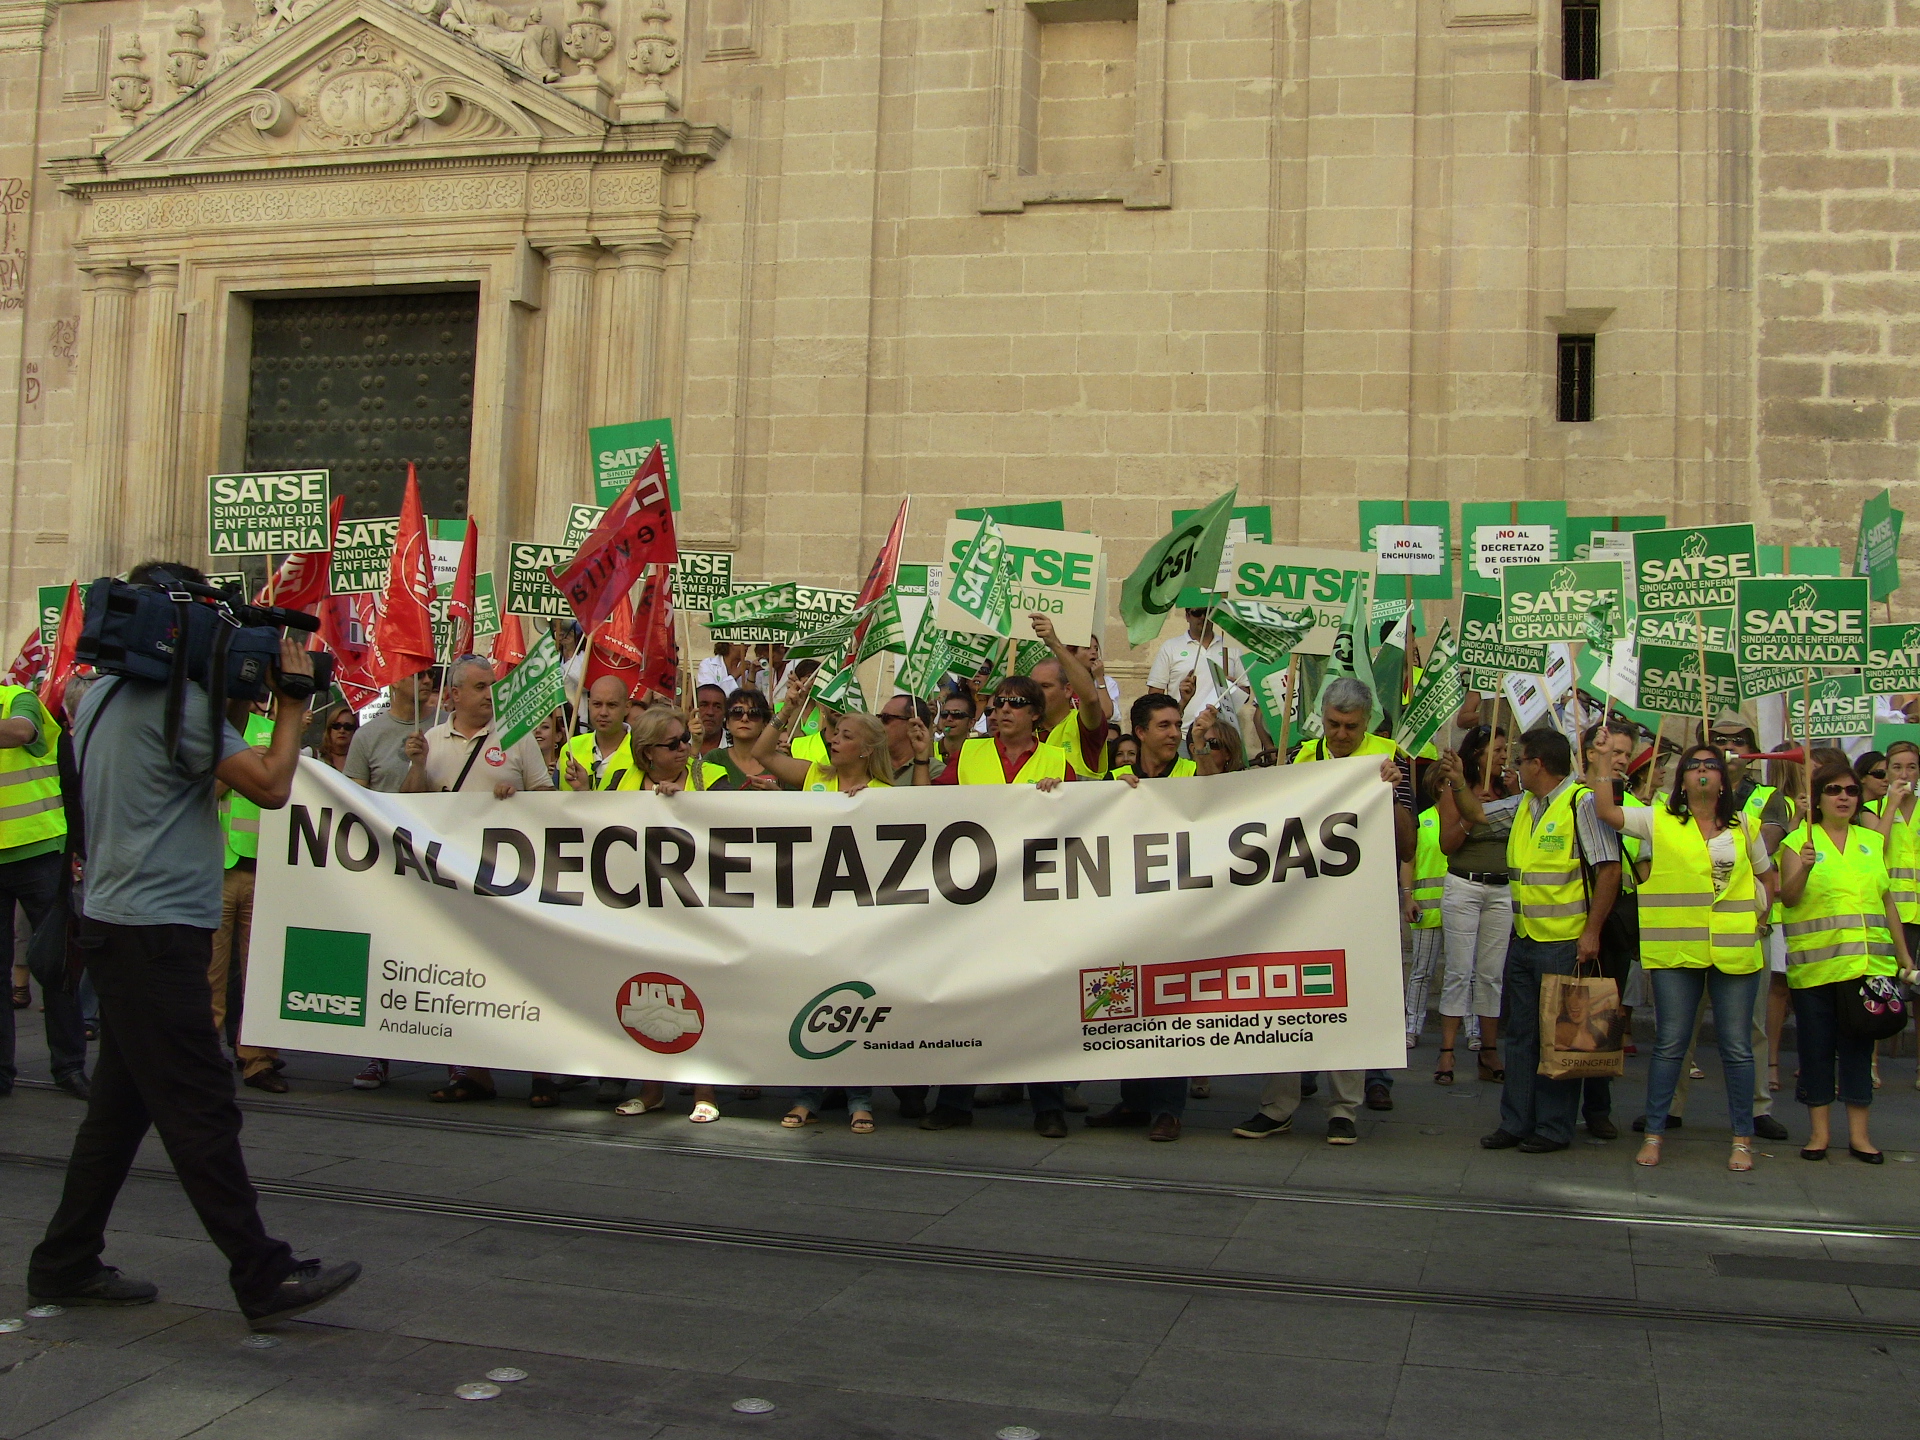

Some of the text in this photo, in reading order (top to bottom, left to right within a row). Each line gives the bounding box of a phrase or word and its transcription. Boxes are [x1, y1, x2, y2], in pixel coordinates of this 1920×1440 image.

[213, 474, 324, 504] SATSE
[214, 502, 323, 518] SINDICATO DE
[214, 515, 323, 530] ENFERMERIA
[1867, 516, 1891, 548] SATSE
[214, 527, 324, 552] ALMERÍA
[334, 521, 398, 549] SATS
[1394, 540, 1411, 549] ¡NO
[1496, 530, 1529, 540] ¡NO AL
[333, 548, 391, 561] SINDICAT
[1381, 552, 1435, 560] ENCHUFISMO!
[1481, 543, 1544, 552] DECRETAZO
[333, 559, 391, 572] ENFERM
[513, 545, 575, 570] SAT
[678, 554, 729, 576] TSE
[949, 539, 1094, 590] STSE
[1499, 555, 1540, 563] GESTIÓN
[432, 565, 457, 573] FISMO
[512, 571, 549, 582] SINDI
[956, 534, 1003, 610] SATS
[1641, 553, 1751, 583] SATSE
[512, 582, 560, 594] ENFER
[672, 584, 727, 595] ERMERIA
[713, 576, 727, 586] DE
[896, 585, 926, 594] SATSE
[929, 579, 939, 588] de
[1639, 579, 1735, 592] SINDICATO DE ENFERM
[510, 594, 570, 613] ALME
[716, 587, 794, 622] SATSE
[795, 589, 857, 614] SATS
[1010, 592, 1064, 615] doba
[1643, 588, 1735, 609] GRANAD
[795, 611, 844, 623] SINDICAT
[1372, 606, 1406, 617] RMERIA
[1508, 611, 1622, 623] SINDICATO DE ENFEIA
[1511, 621, 1619, 639] GRANA
[1743, 609, 1862, 635] SATSE
[1640, 618, 1726, 646] SATSE
[1740, 635, 1864, 644] SINDICATO DE ENFERMERIA
[1460, 640, 1493, 650] SINDICATO
[1504, 644, 1544, 657] ENFERMERIA
[1744, 644, 1861, 661] GRANADA
[1461, 648, 1540, 671] GRANADA
[1868, 648, 1920, 670] SAT
[497, 638, 560, 711] SATSE
[1642, 668, 1738, 697] SATSE
[1741, 669, 1770, 682] SINDICATO
[1772, 668, 1780, 676] DE
[1865, 668, 1917, 678] SINDICATO DE
[1869, 676, 1920, 691] GRAN
[504, 681, 546, 720] SINDICATO
[1405, 671, 1453, 728] SINDICATO
[1436, 689, 1465, 720] CADIZ
[1639, 686, 1737, 704] SINDICATO DE ENERMERIA
[526, 698, 556, 727] CADIZ
[1791, 696, 1870, 717] SATSE
[1831, 713, 1871, 722] ENFERMERIA
[1791, 720, 1868, 736] GRANADA
[287, 804, 1361, 909] NO AL DECRETAZO EN EL SAS
[382, 959, 487, 989] Sindicato
[287, 990, 361, 1017] SATSE
[630, 981, 686, 1008] UGT
[380, 988, 541, 1022] de Enfermería
[379, 1019, 453, 1038] Andalucía
[1081, 1011, 1348, 1036] federación de sanidad y sectores
[863, 1038, 983, 1050] Sanidad Andalucía
[1082, 1028, 1314, 1051] sociosanitarios de Andalucía
[1561, 1058, 1618, 1067] SPRINGFIELD
